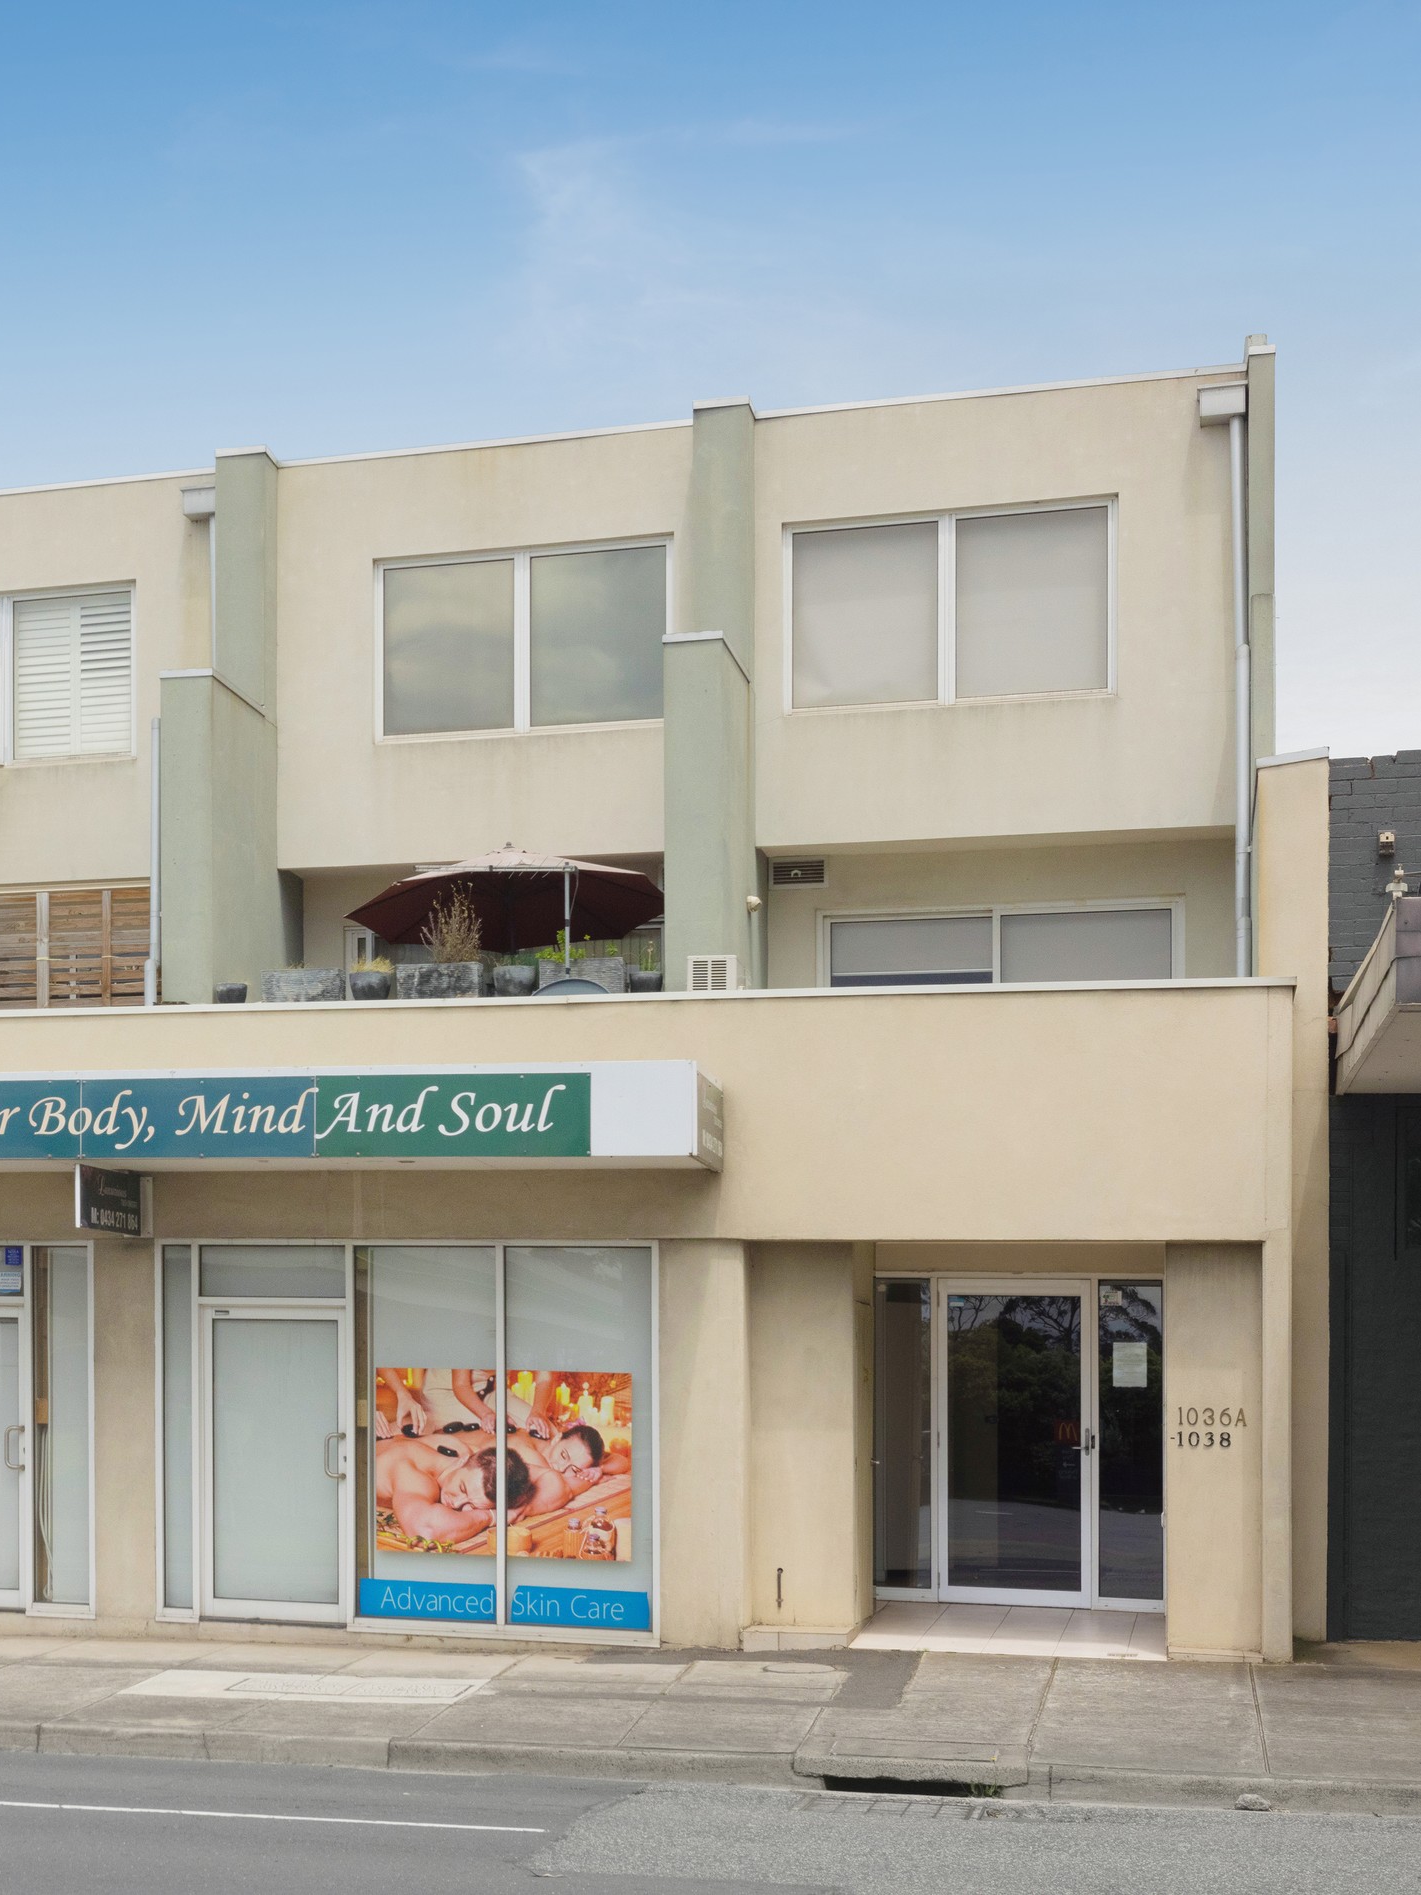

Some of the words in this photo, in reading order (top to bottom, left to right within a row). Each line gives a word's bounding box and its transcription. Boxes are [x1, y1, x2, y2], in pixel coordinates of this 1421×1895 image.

[28, 1089, 156, 1151] Body,
[174, 1086, 319, 1135] Mind
[315, 1085, 440, 1140] And
[438, 1083, 567, 1137] Soul
[1177, 1406, 1248, 1427] 1036A
[380, 1585, 495, 1616] Advanced
[511, 1590, 561, 1618] Skin
[569, 1595, 626, 1622] Care
